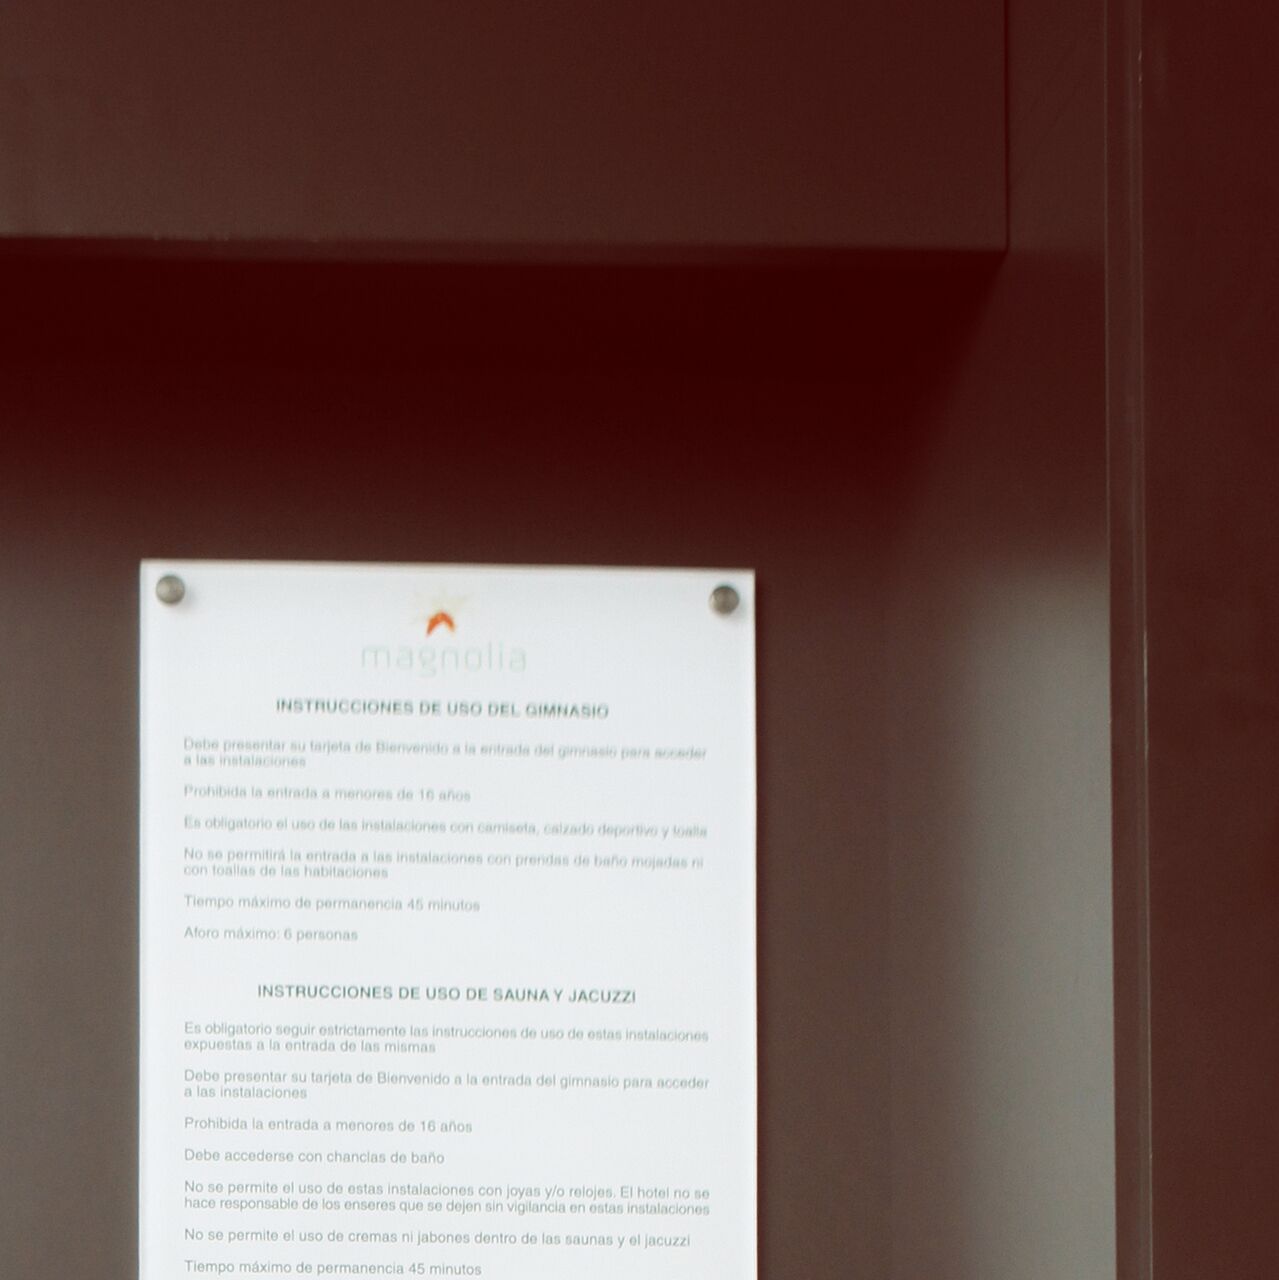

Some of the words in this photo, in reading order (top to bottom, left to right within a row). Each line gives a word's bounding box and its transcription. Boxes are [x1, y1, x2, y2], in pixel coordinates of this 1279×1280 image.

[360, 640, 527, 677] magnolia
[275, 697, 413, 714] INSTRUCCIONES
[418, 701, 441, 715] DE
[446, 701, 482, 716] USO
[487, 702, 518, 717] DEL
[525, 703, 609, 719] GIMNASIO
[183, 784, 247, 798] Prohibida
[250, 785, 263, 798] la
[266, 786, 318, 799] entrada
[321, 789, 330, 799] a
[334, 790, 393, 800] menores
[396, 787, 413, 800] de
[419, 788, 434, 800] 16
[438, 788, 471, 801] años
[184, 894, 234, 911] Tiempo
[237, 895, 291, 908] máximo
[294, 896, 311, 909] de
[315, 896, 402, 913] permanencia
[407, 897, 423, 910] 45
[427, 898, 480, 911] minutos
[183, 925, 219, 938] Aforo
[283, 927, 292, 939] 6
[295, 930, 358, 943] personas
[257, 984, 392, 1000] INSTRUCCIONES
[398, 986, 419, 1000] DE
[425, 987, 460, 1001] USO
[465, 987, 487, 1001] DE
[492, 988, 549, 1002] SAUNA
[553, 988, 562, 1002] Y
[568, 989, 636, 1003] JACUZZI
[184, 1022, 201, 1034] Es
[204, 1022, 272, 1038] obligatorio
[275, 1023, 314, 1038] seguir
[318, 1024, 406, 1037] estrictamente
[409, 1025, 428, 1037] las
[431, 1025, 517, 1038] instrucciones
[520, 1026, 537, 1039] de
[540, 1029, 564, 1039] uso
[567, 1027, 584, 1039] de
[586, 1027, 622, 1040] estas
[625, 1028, 708, 1041] instalaciones
[183, 1037, 252, 1053] expuestas
[256, 1041, 264, 1051] a
[268, 1038, 280, 1051] la
[284, 1038, 335, 1051] entrada
[339, 1039, 356, 1051] de
[360, 1039, 380, 1052] las
[384, 1039, 436, 1052] mismas
[183, 1069, 220, 1081] Debe
[223, 1069, 286, 1085] presentar
[290, 1073, 307, 1083] su
[310, 1070, 352, 1086] tarjeta
[356, 1071, 373, 1084] de
[376, 1071, 450, 1085] Bienvenido
[454, 1075, 462, 1085] a
[466, 1072, 478, 1085] la
[481, 1073, 532, 1086] entrada
[535, 1073, 556, 1086] del
[559, 1074, 619, 1090] gimnasio
[622, 1077, 652, 1090] para
[656, 1075, 708, 1088] acceder
[183, 1087, 192, 1097] a
[196, 1084, 216, 1097] las
[219, 1085, 307, 1098] instalaciones
[184, 1115, 247, 1129] Prohibida
[251, 1116, 263, 1129] la
[267, 1117, 318, 1130] entrada
[322, 1120, 331, 1130] a
[335, 1120, 394, 1131] menores
[398, 1118, 415, 1131] de
[421, 1119, 436, 1131] 16
[440, 1119, 472, 1132] años
[184, 1147, 220, 1160] Debe
[224, 1148, 294, 1161] accederse
[297, 1152, 322, 1162] con
[326, 1149, 386, 1162] chanclas
[389, 1150, 407, 1163] de
[410, 1150, 444, 1163] baño
[184, 1179, 203, 1192] No
[207, 1183, 223, 1192] se
[227, 1180, 278, 1196] permite
[282, 1181, 294, 1193] el
[298, 1184, 322, 1194] uso
[326, 1181, 343, 1194] de
[347, 1181, 383, 1194] estas
[387, 1182, 474, 1195] instalaciones
[478, 1186, 502, 1196] con
[506, 1183, 540, 1199] joyas
[544, 1184, 565, 1199] y/o
[568, 1184, 615, 1200] relojes.
[619, 1184, 633, 1197] El
[636, 1185, 669, 1198] hotel
[673, 1188, 690, 1198] no
[694, 1188, 710, 1198] se
[184, 1196, 216, 1208] hace
[219, 1196, 298, 1212] responsable
[301, 1197, 318, 1210] de
[321, 1197, 340, 1210] los
[343, 1201, 396, 1210] enseres
[398, 1201, 423, 1213] que
[426, 1202, 442, 1211] se
[445, 1199, 481, 1214] dejen
[484, 1199, 503, 1212] sin
[506, 1200, 566, 1215] vigilancia
[569, 1203, 586, 1213] en
[588, 1201, 624, 1213] estas
[626, 1201, 710, 1214] instalaciones
[184, 1227, 203, 1240] No
[207, 1231, 223, 1240] se
[227, 1228, 278, 1244] permite
[282, 1229, 294, 1241] el
[298, 1232, 323, 1242] uso
[326, 1229, 344, 1242] de
[347, 1232, 397, 1243] cremas
[401, 1230, 413, 1243] ni
[417, 1230, 470, 1246] jabones
[474, 1231, 517, 1244] dentro
[520, 1231, 537, 1244] de
[541, 1232, 561, 1244] las
[564, 1235, 613, 1245] saunas
[617, 1236, 624, 1248] y
[628, 1233, 641, 1245] el
[644, 1233, 690, 1249] jacuzzi
[184, 1258, 234, 1274] Tiempo
[238, 1259, 292, 1272] máximo
[295, 1259, 312, 1272] de
[316, 1260, 404, 1276] permanencia
[408, 1261, 425, 1273] 45
[429, 1261, 482, 1274] minutos
